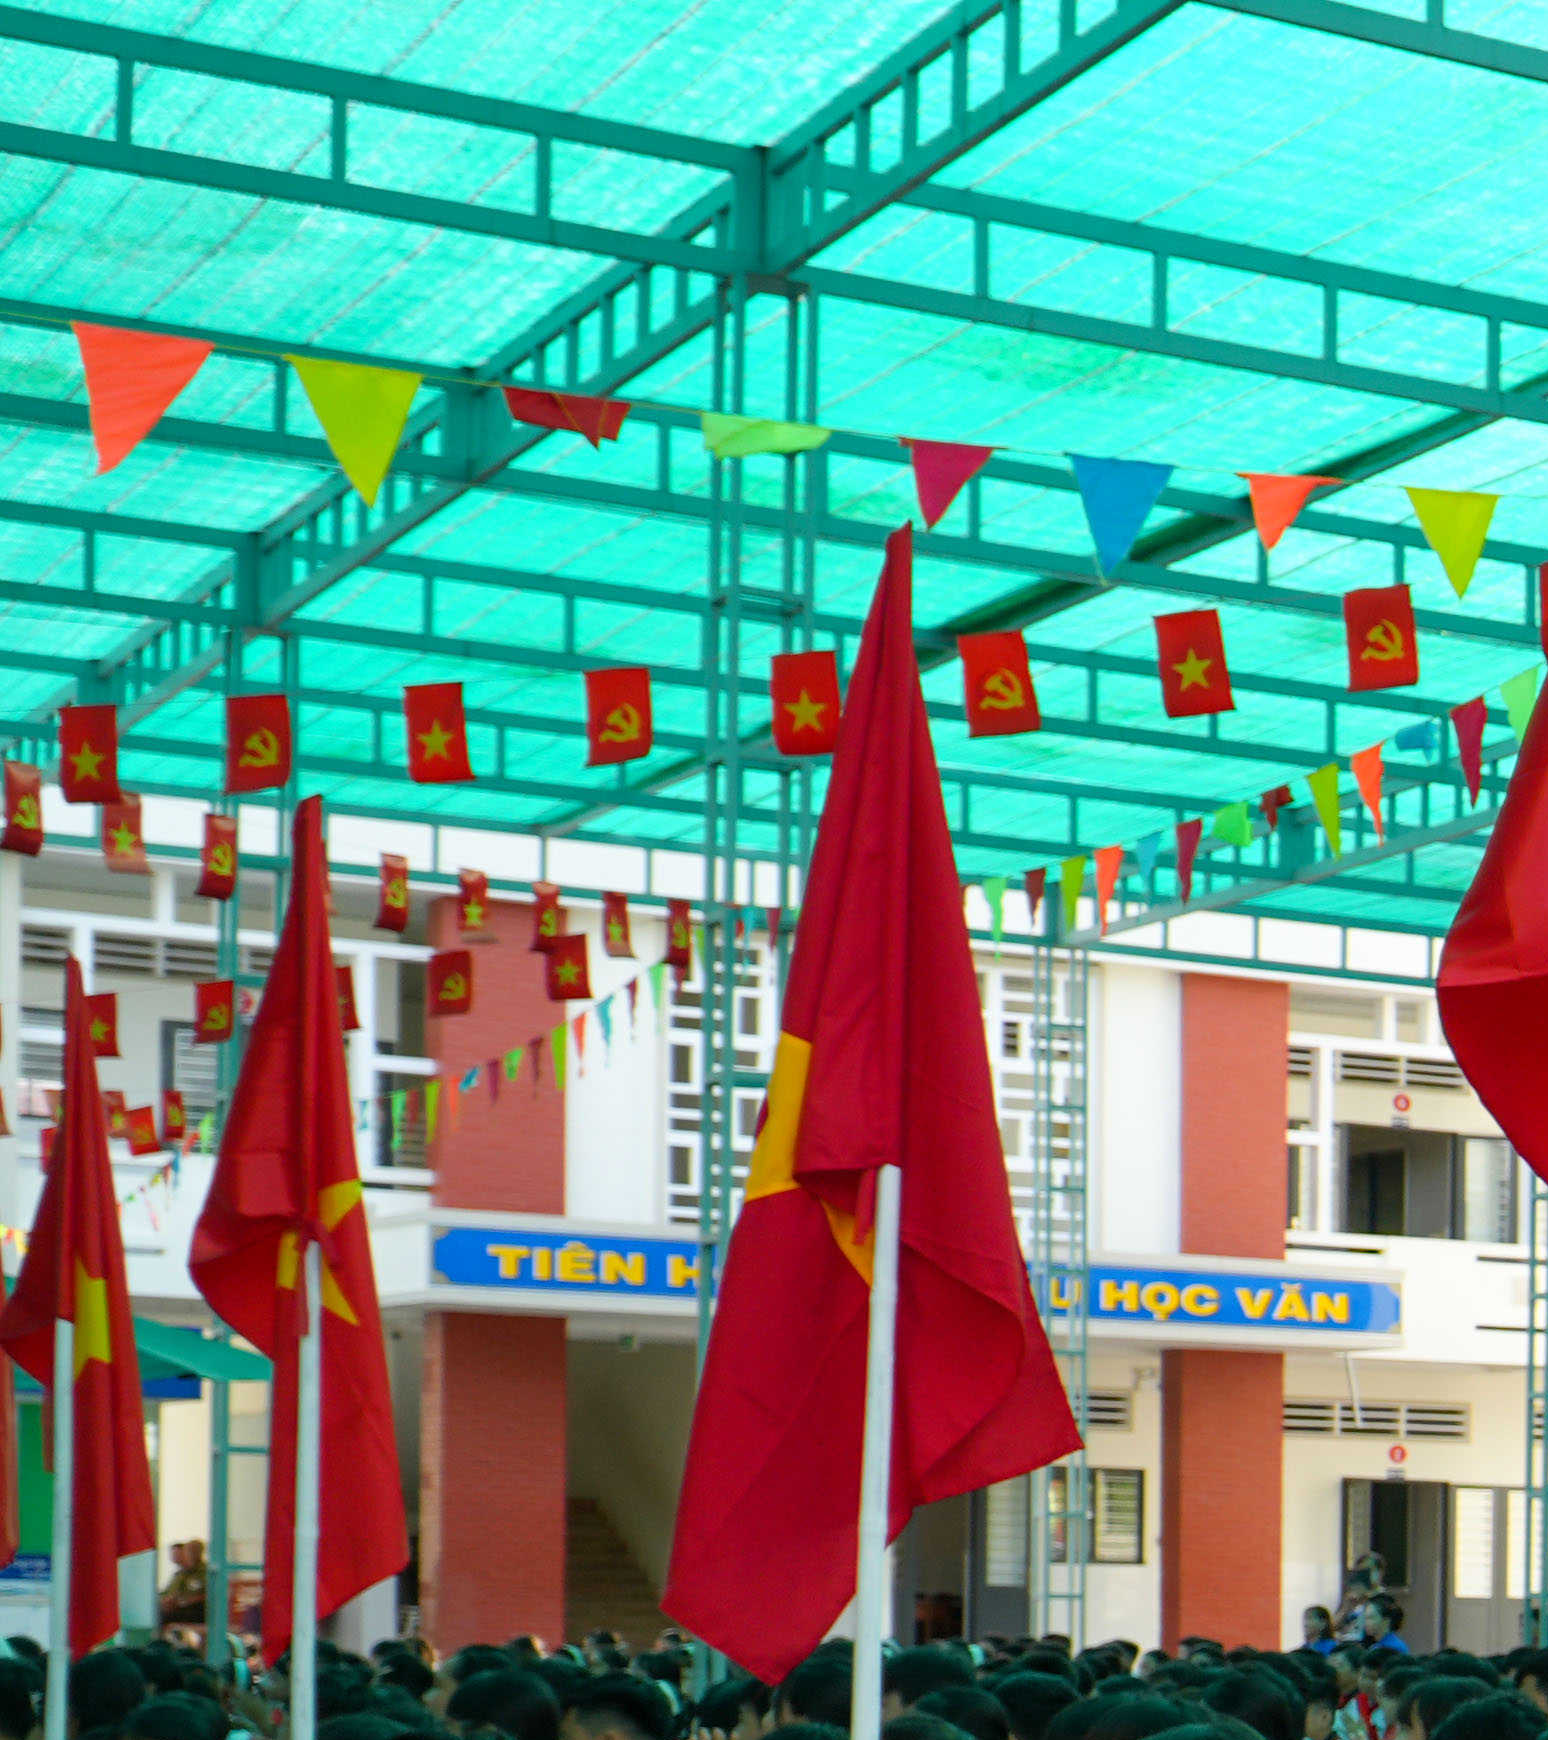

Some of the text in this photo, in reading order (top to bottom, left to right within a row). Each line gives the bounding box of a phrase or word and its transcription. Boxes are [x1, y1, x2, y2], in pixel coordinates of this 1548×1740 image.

[486, 1240, 646, 1287] TIÊN
[1099, 1279, 1220, 1321] HỌC
[1235, 1281, 1350, 1324] VĂN
